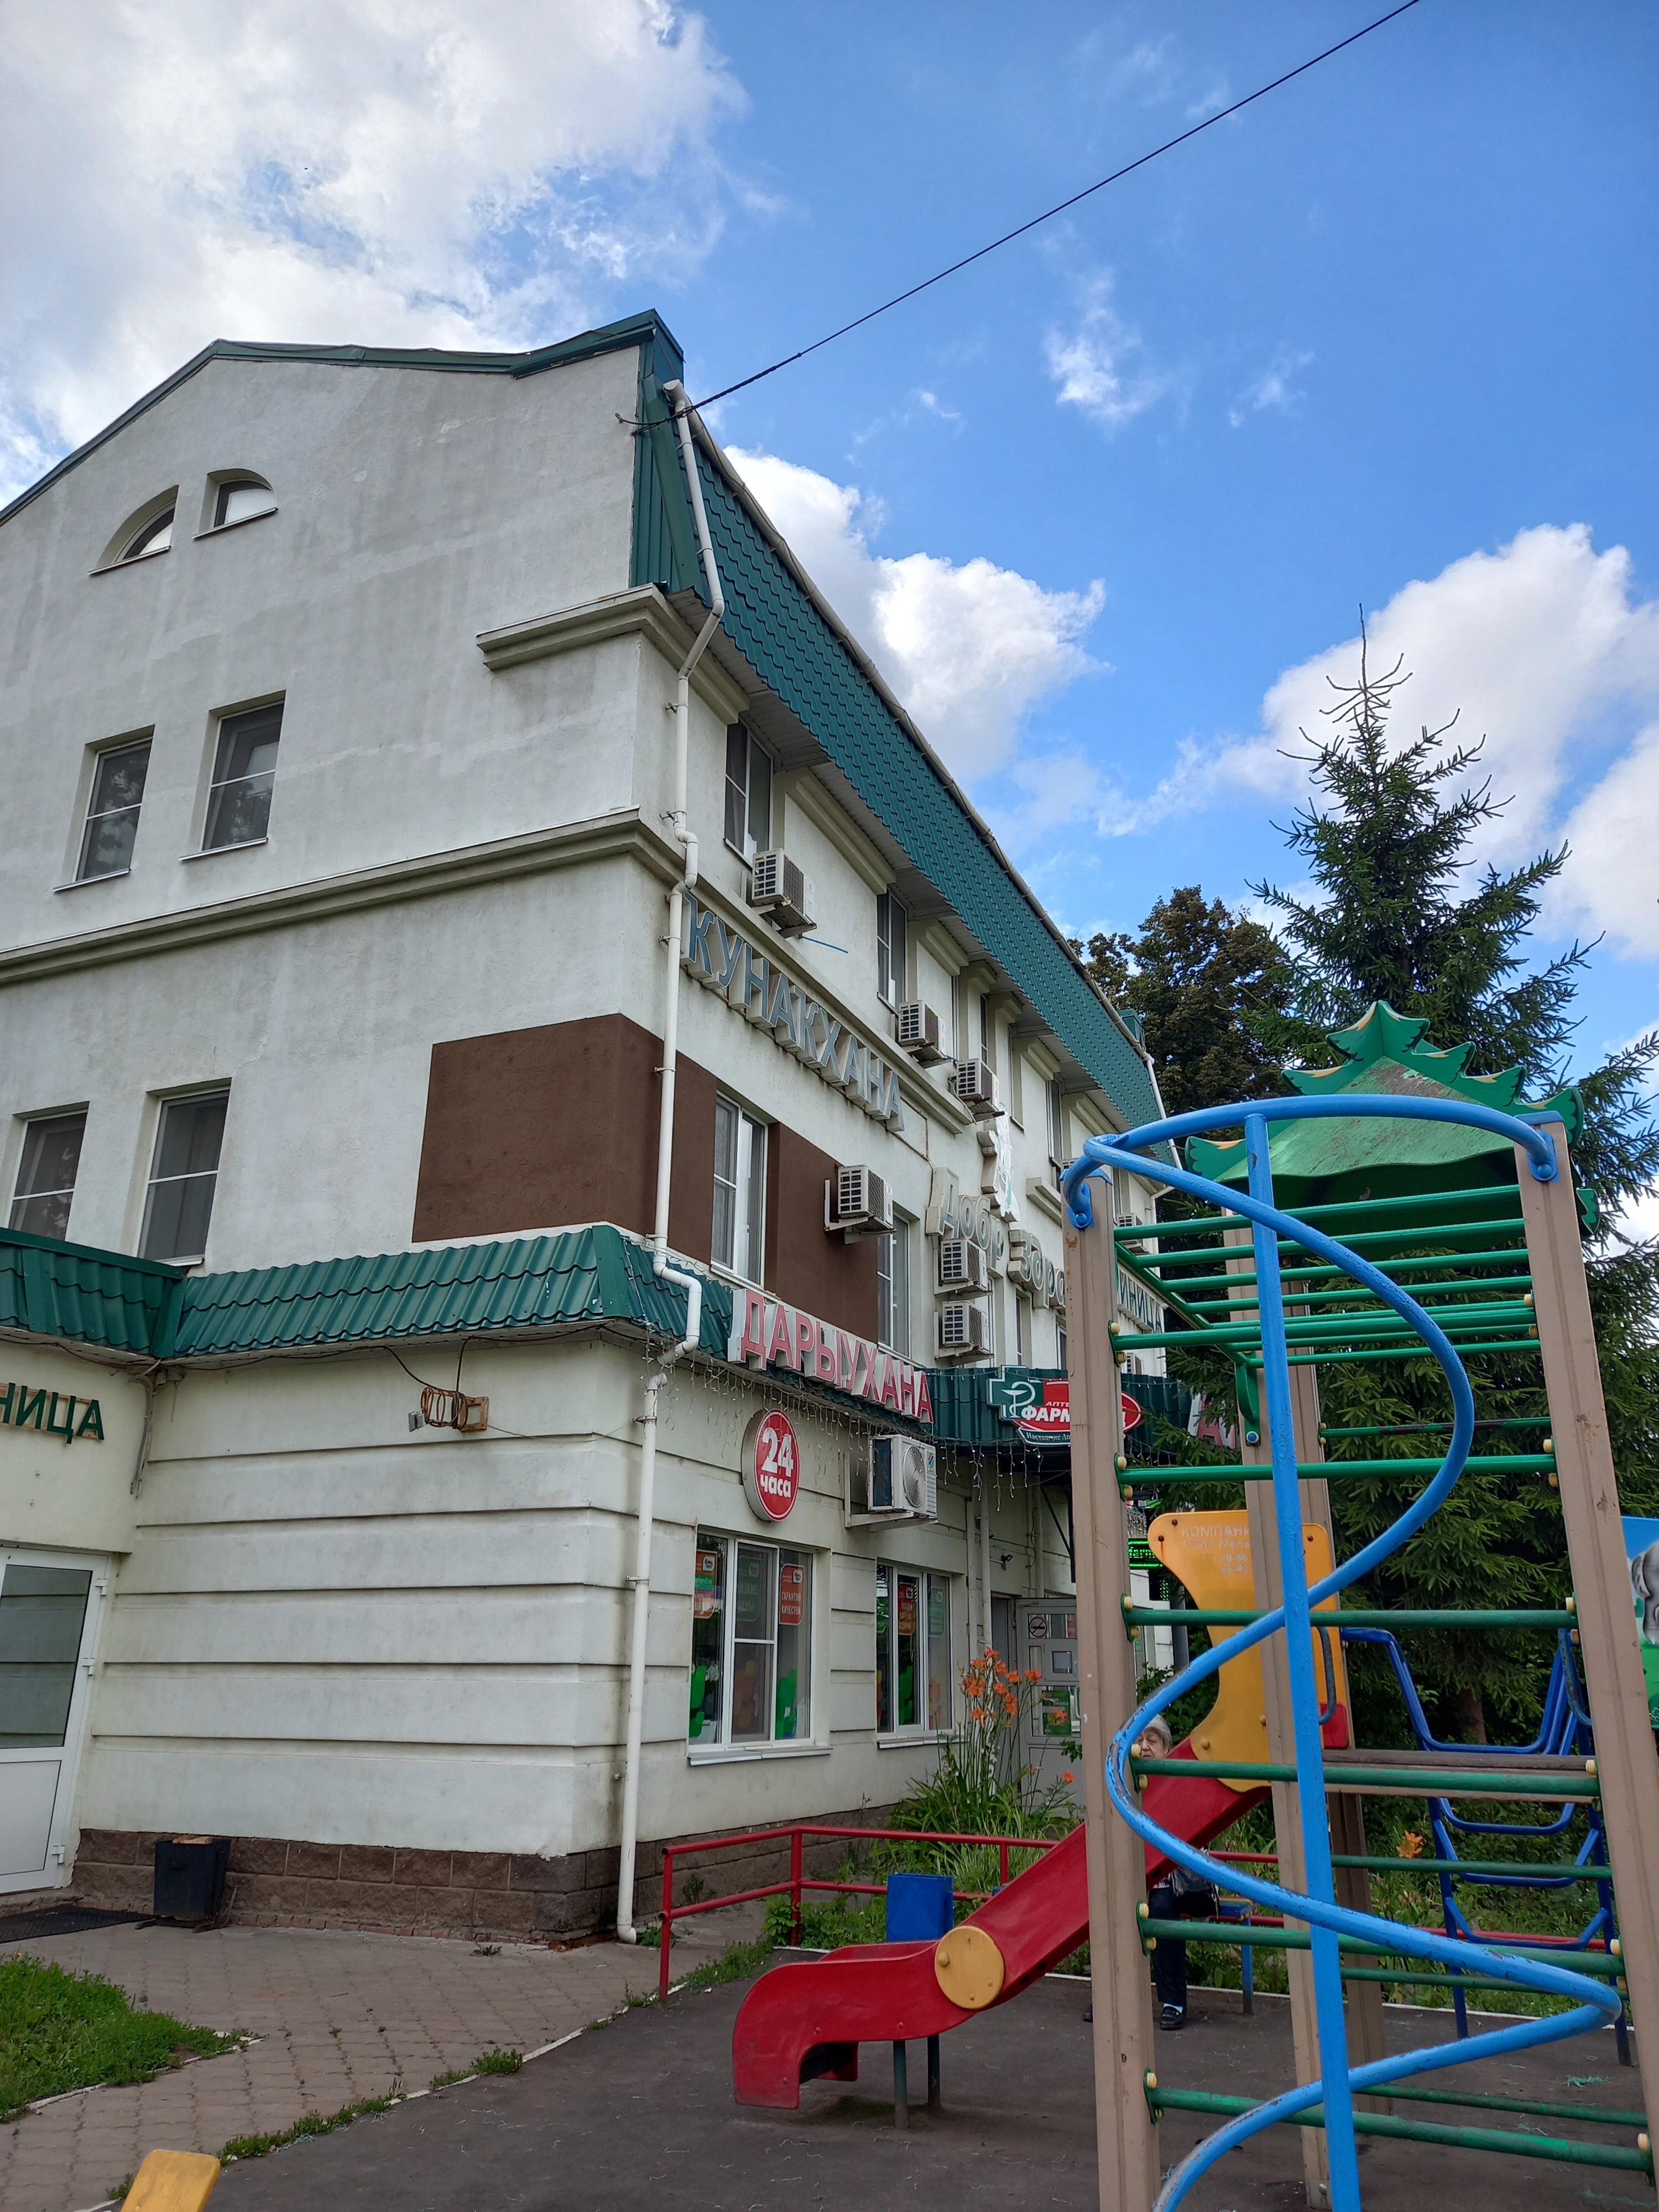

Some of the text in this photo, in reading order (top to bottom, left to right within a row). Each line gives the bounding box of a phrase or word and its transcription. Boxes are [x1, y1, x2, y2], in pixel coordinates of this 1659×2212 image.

[1119, 1269, 1162, 1333] ИНИЦА
[740, 1289, 934, 1424] ДАРЫУХАНА
[761, 1427, 794, 1477] 24
[760, 1474, 791, 1498] часа
[1181, 1526, 1250, 1537] КОМПАНИ
